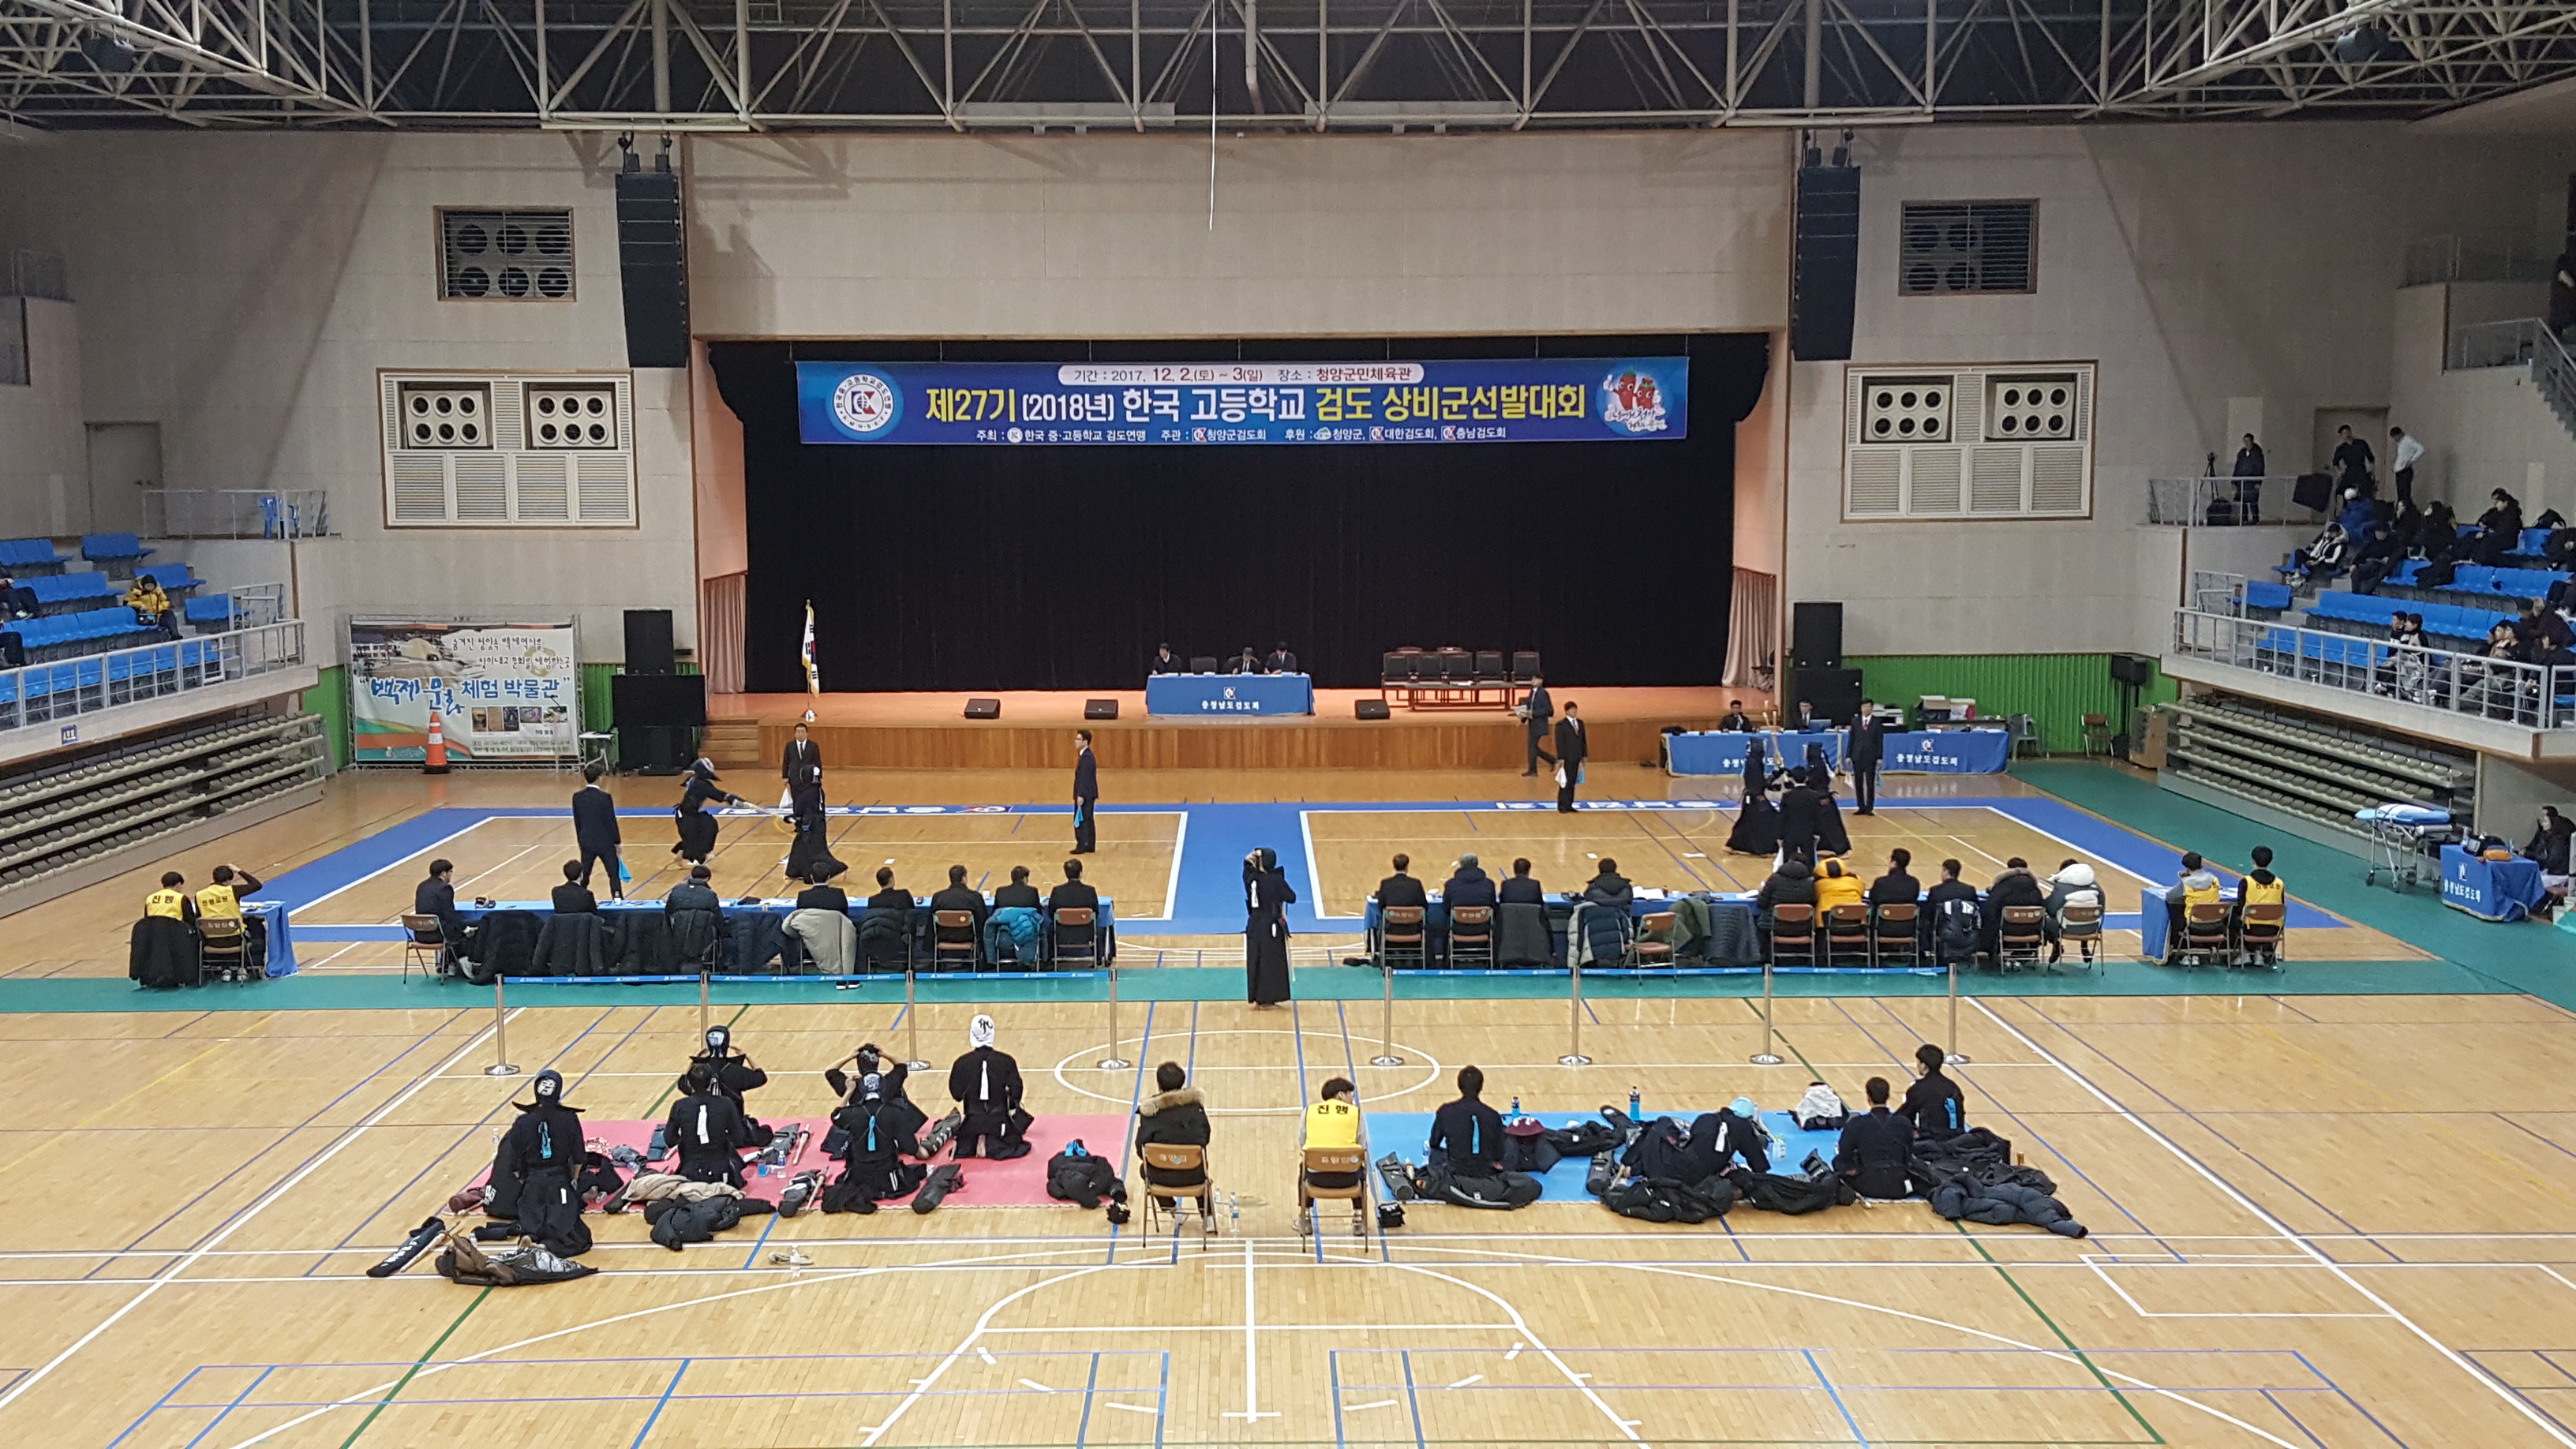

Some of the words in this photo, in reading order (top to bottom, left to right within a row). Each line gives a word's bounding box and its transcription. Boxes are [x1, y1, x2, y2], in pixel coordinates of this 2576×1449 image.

[1074, 370, 1098, 382] 기간
[1152, 368, 1175, 381] 12.
[1232, 367, 1264, 382] 3(일)
[1278, 369, 1302, 381] 장소
[1316, 367, 1413, 381] 청양군민체육관
[925, 388, 1016, 423] 제27기
[1122, 388, 1181, 423] 한국
[1190, 388, 1306, 423] 고등학교
[1316, 387, 1373, 421] 검도
[1382, 384, 1586, 422] 상비군선발대회
[975, 429, 997, 442] 주최
[1024, 429, 1045, 442] 한국
[1106, 429, 1146, 442] 검도연맹
[1161, 429, 1181, 442] 주관
[1207, 429, 1266, 441] 청양군검도회
[1285, 429, 1305, 441] 후원
[1456, 427, 1507, 440] 충남검도회
[461, 679, 498, 699] 체험
